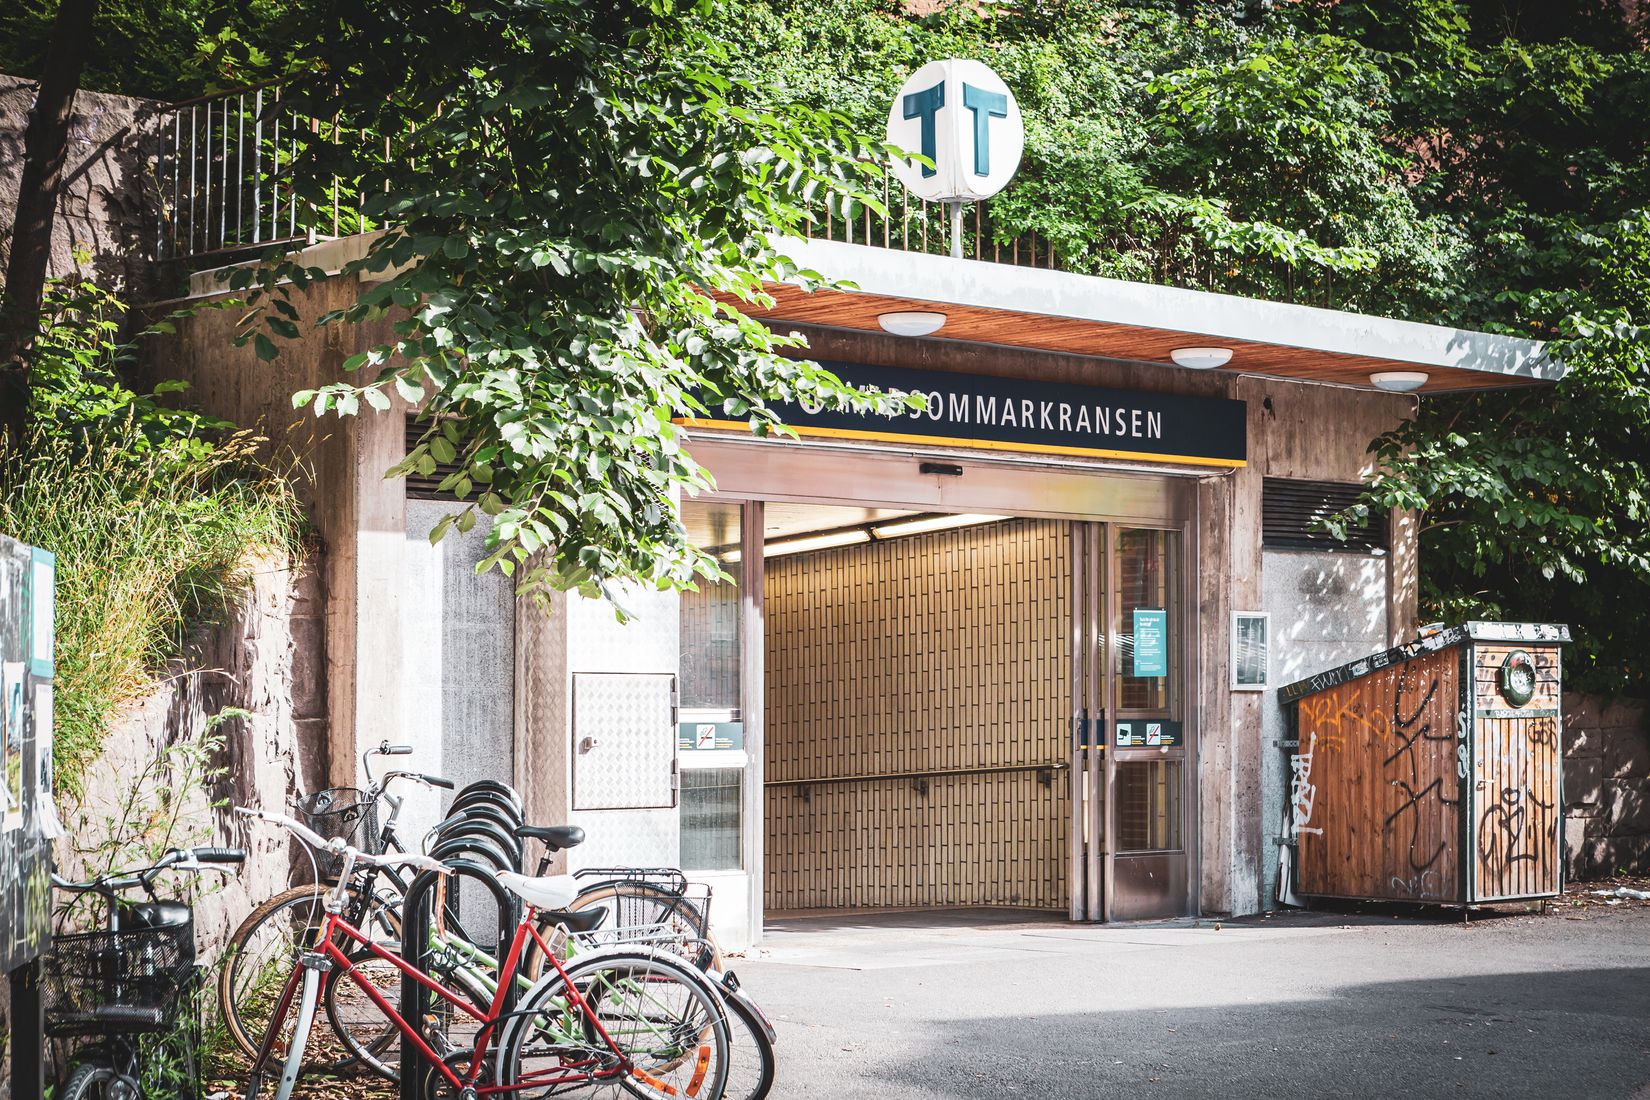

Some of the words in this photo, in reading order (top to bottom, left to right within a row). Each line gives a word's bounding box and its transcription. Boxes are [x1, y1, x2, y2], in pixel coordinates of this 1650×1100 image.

[903, 80, 945, 179] T
[962, 81, 1008, 178] T
[845, 382, 1161, 439] SOMMARKRANSEN
